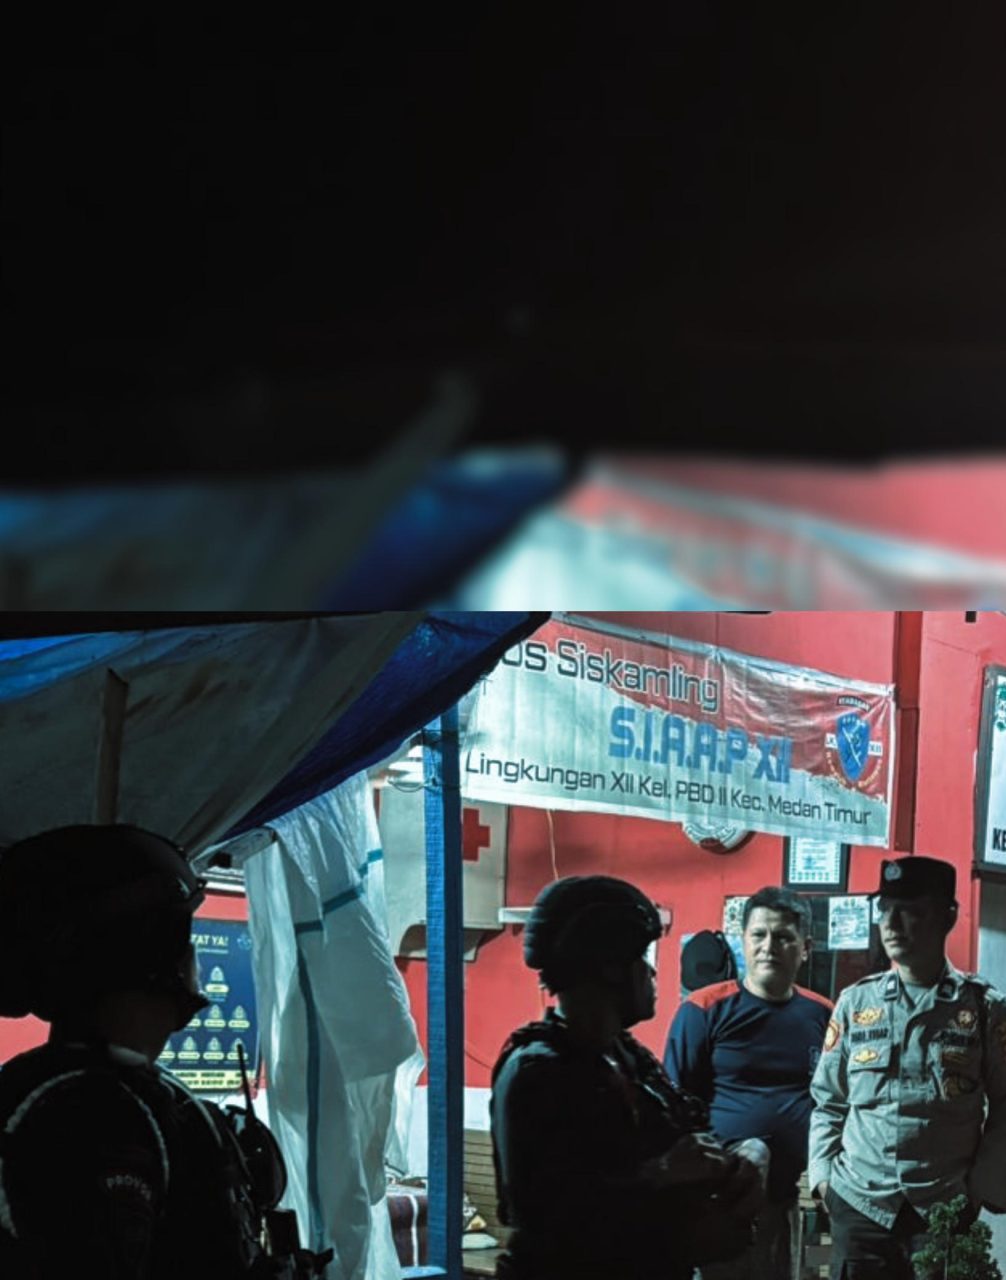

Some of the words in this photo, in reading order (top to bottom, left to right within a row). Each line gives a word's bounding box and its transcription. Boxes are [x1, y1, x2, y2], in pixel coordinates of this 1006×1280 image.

[557, 640, 719, 712] Siskamling
[465, 751, 605, 790] Lingkungan
[610, 771, 634, 795] XII
[639, 775, 671, 799] Kel.
[676, 780, 714, 804] PBD
[731, 788, 765, 811] Kec.
[769, 794, 821, 820] Medan
[824, 802, 871, 825] Timur
[753, 736, 793, 784] XII
